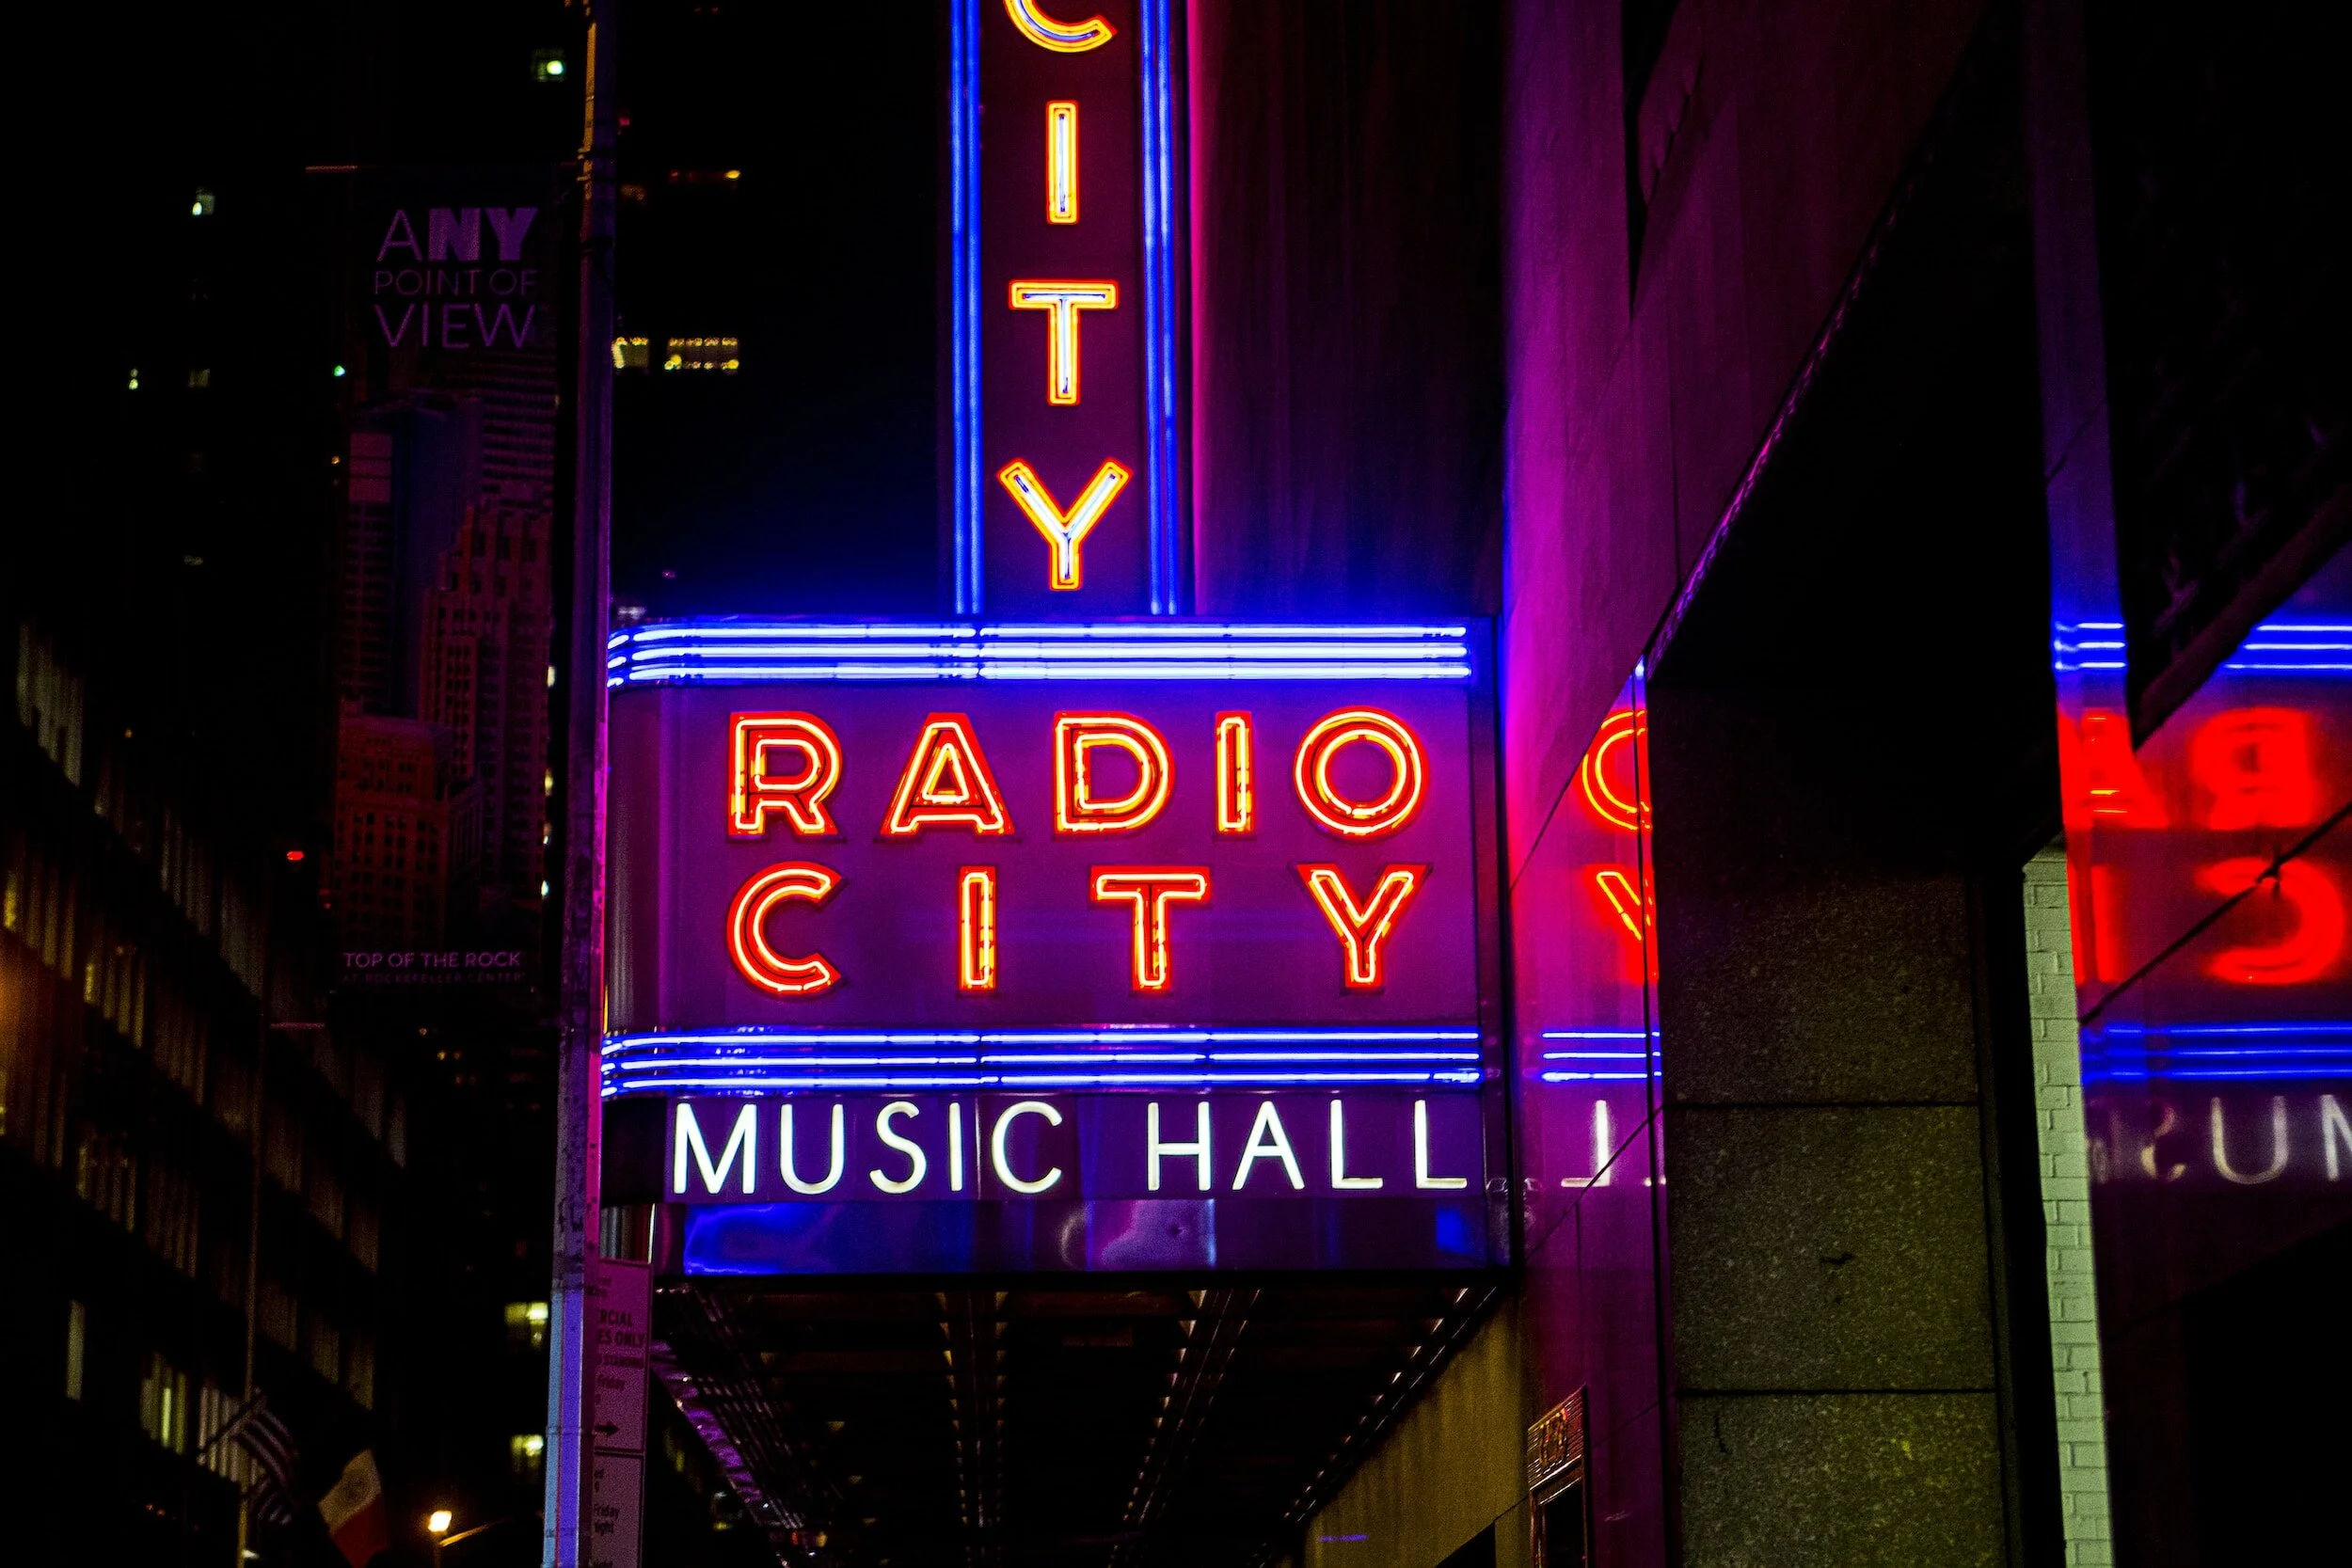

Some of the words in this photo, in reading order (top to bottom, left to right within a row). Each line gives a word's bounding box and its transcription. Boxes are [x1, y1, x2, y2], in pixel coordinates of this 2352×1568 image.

[376, 205, 540, 263] ANY
[373, 268, 482, 296] POINT
[487, 268, 537, 296] OF
[373, 302, 538, 349] VIEW
[727, 706, 1429, 839] RADIO
[726, 860, 1431, 997] CITY
[342, 952, 384, 968] TOP
[388, 952, 415, 968] OF
[421, 952, 459, 968] THE
[465, 950, 522, 968] ROCK
[673, 1100, 1063, 1195] MUSIC
[1147, 1098, 1468, 1191] HALL
